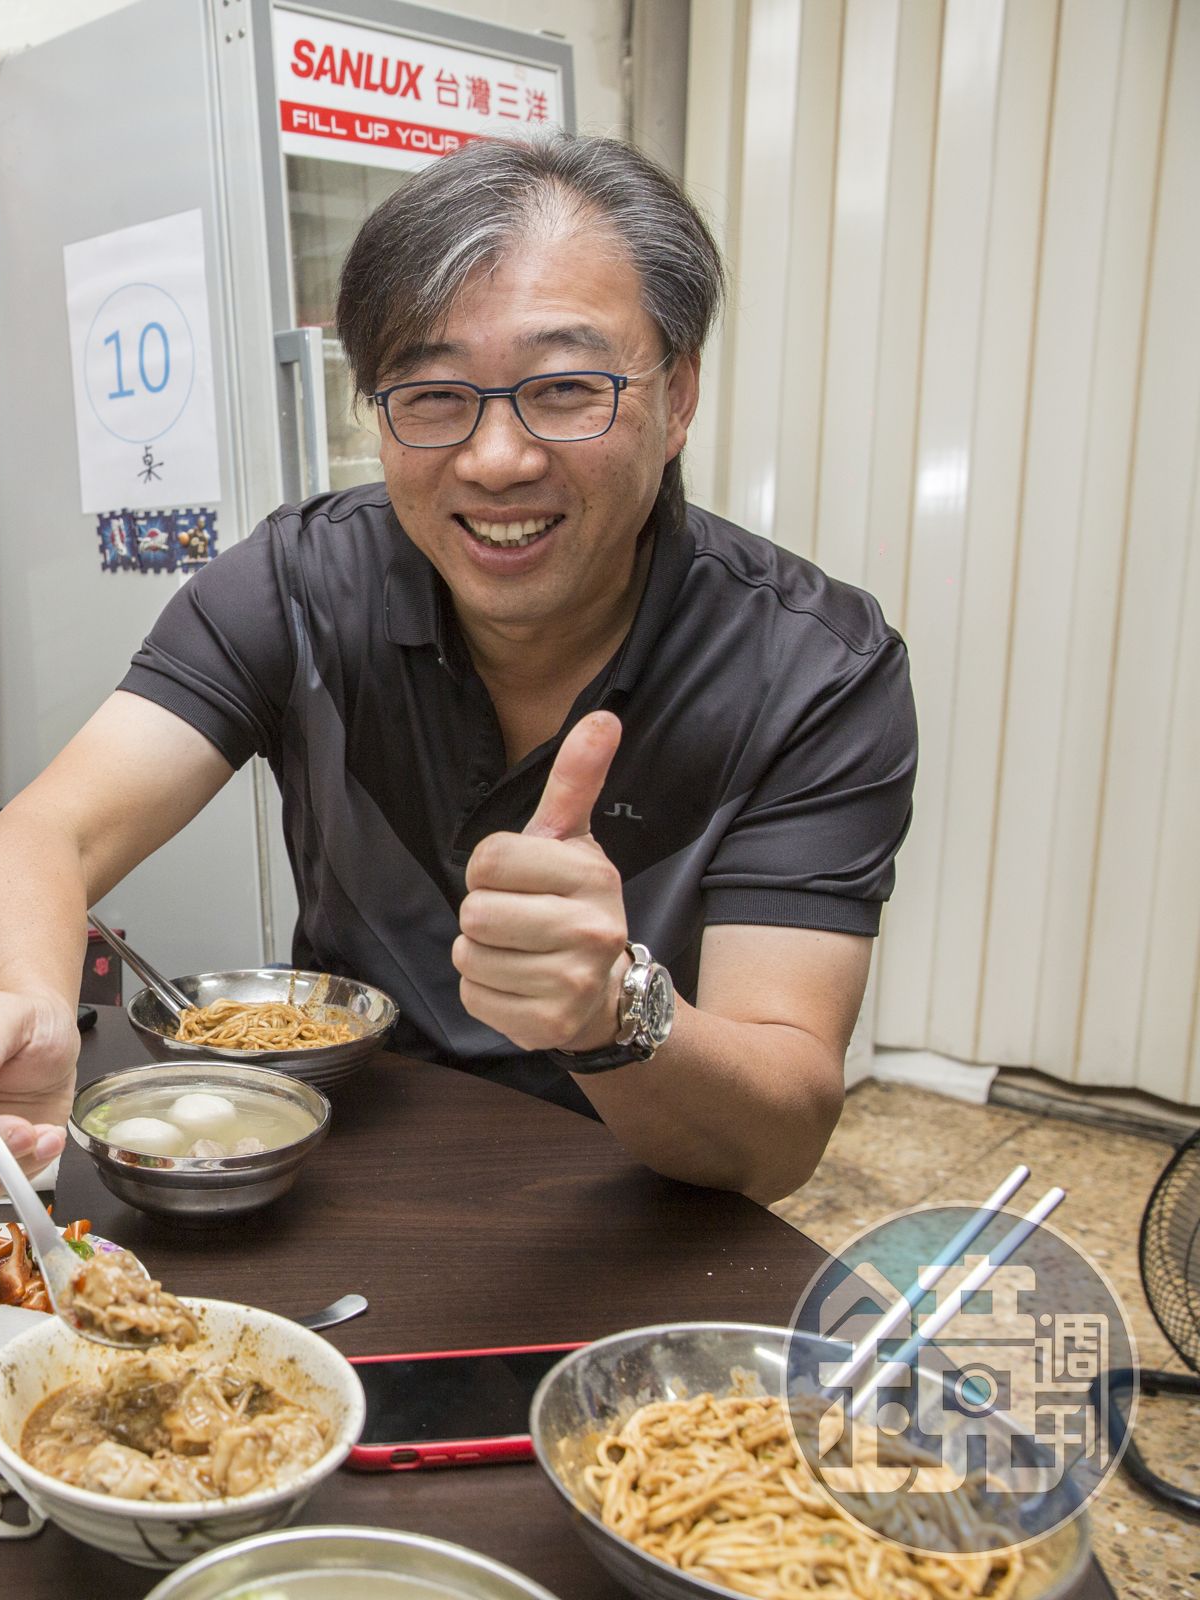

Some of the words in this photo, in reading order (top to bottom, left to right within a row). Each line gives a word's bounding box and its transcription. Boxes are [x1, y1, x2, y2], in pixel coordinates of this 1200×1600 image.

[291, 38, 424, 101] SANLUX
[434, 67, 549, 124] 台灣三洋
[292, 109, 348, 136] FILL
[355, 120, 391, 139] UP
[103, 321, 170, 400] 10
